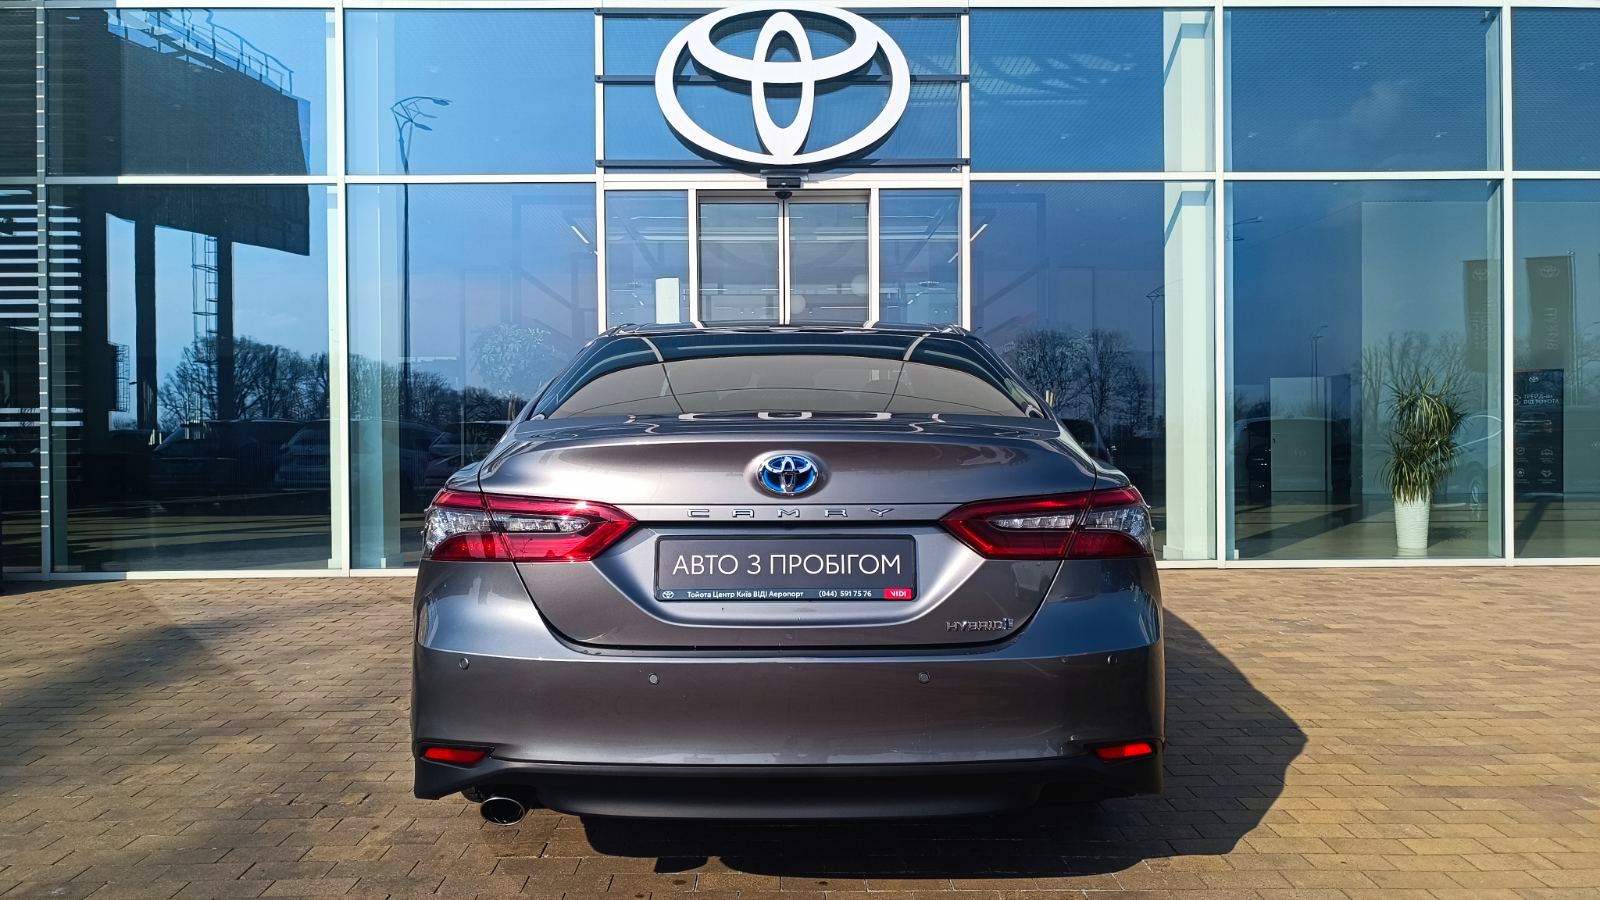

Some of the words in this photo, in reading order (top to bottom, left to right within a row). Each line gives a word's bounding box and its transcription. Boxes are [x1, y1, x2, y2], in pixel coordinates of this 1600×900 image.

[687, 508, 895, 518] CAMRY
[672, 554, 738, 575] АВТО
[770, 553, 901, 575] ПРОБІГОМ
[713, 591, 734, 599] Центр
[769, 591, 804, 599] Аеропорт
[818, 590, 838, 598] (044)
[945, 621, 1003, 631] HYBRID
